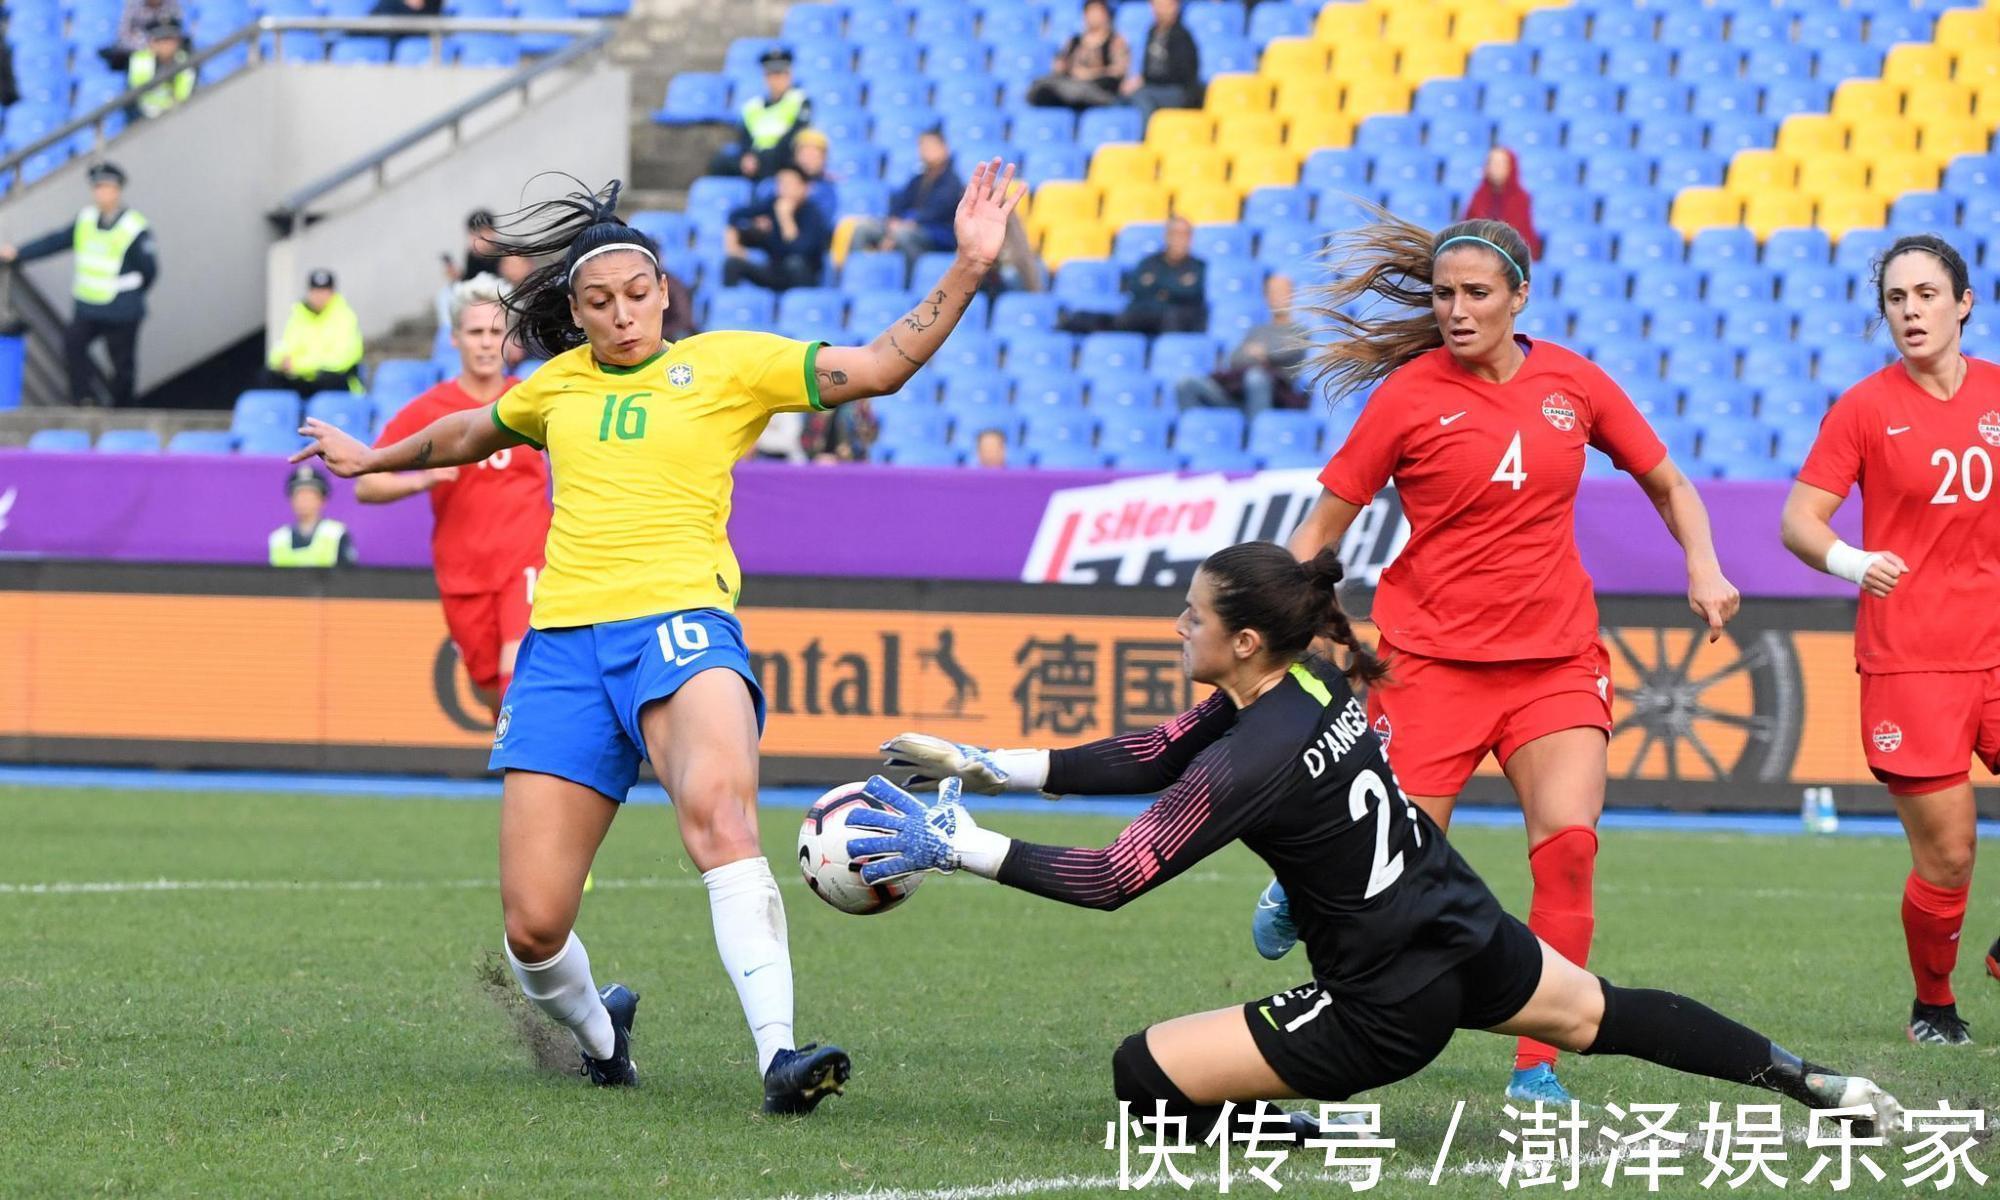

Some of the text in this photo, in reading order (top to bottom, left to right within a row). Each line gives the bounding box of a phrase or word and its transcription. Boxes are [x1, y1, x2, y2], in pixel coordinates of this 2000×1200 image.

[599, 392, 652, 442] 16
[1543, 408, 1575, 418] CANADA
[1490, 429, 1528, 490] 4
[1930, 445, 1993, 504] 20
[656, 615, 710, 663] 16
[1013, 634, 1192, 738] 德国
[1348, 769, 1422, 899] 2
